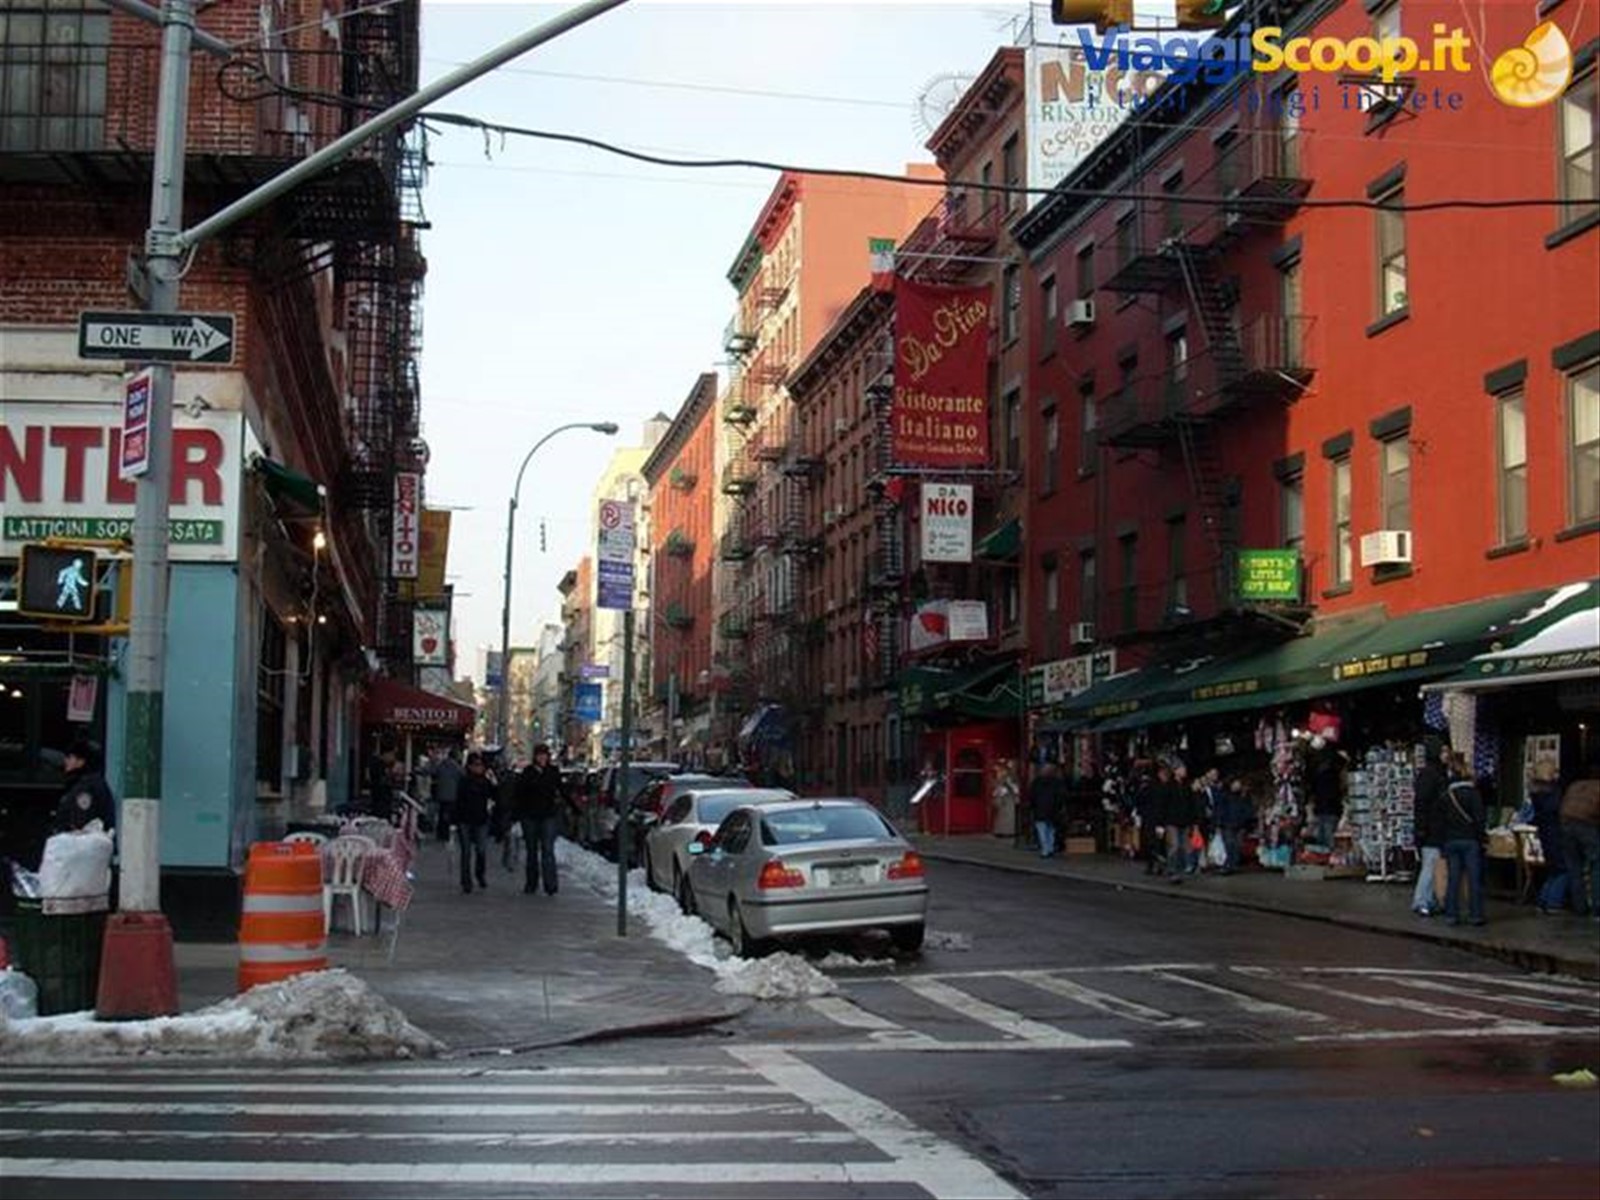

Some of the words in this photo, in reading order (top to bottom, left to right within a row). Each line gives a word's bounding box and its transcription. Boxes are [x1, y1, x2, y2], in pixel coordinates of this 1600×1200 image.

[101, 326, 141, 345] ONE
[171, 329, 214, 348] WAY
[896, 387, 983, 413] Ristorante
[900, 416, 977, 440] Italiano
[938, 487, 958, 497] DA
[928, 498, 968, 516] NICO
[8, 520, 87, 537] LATTICINI
[97, 522, 215, 540] SOPSATA
[394, 707, 445, 719] BENITO
